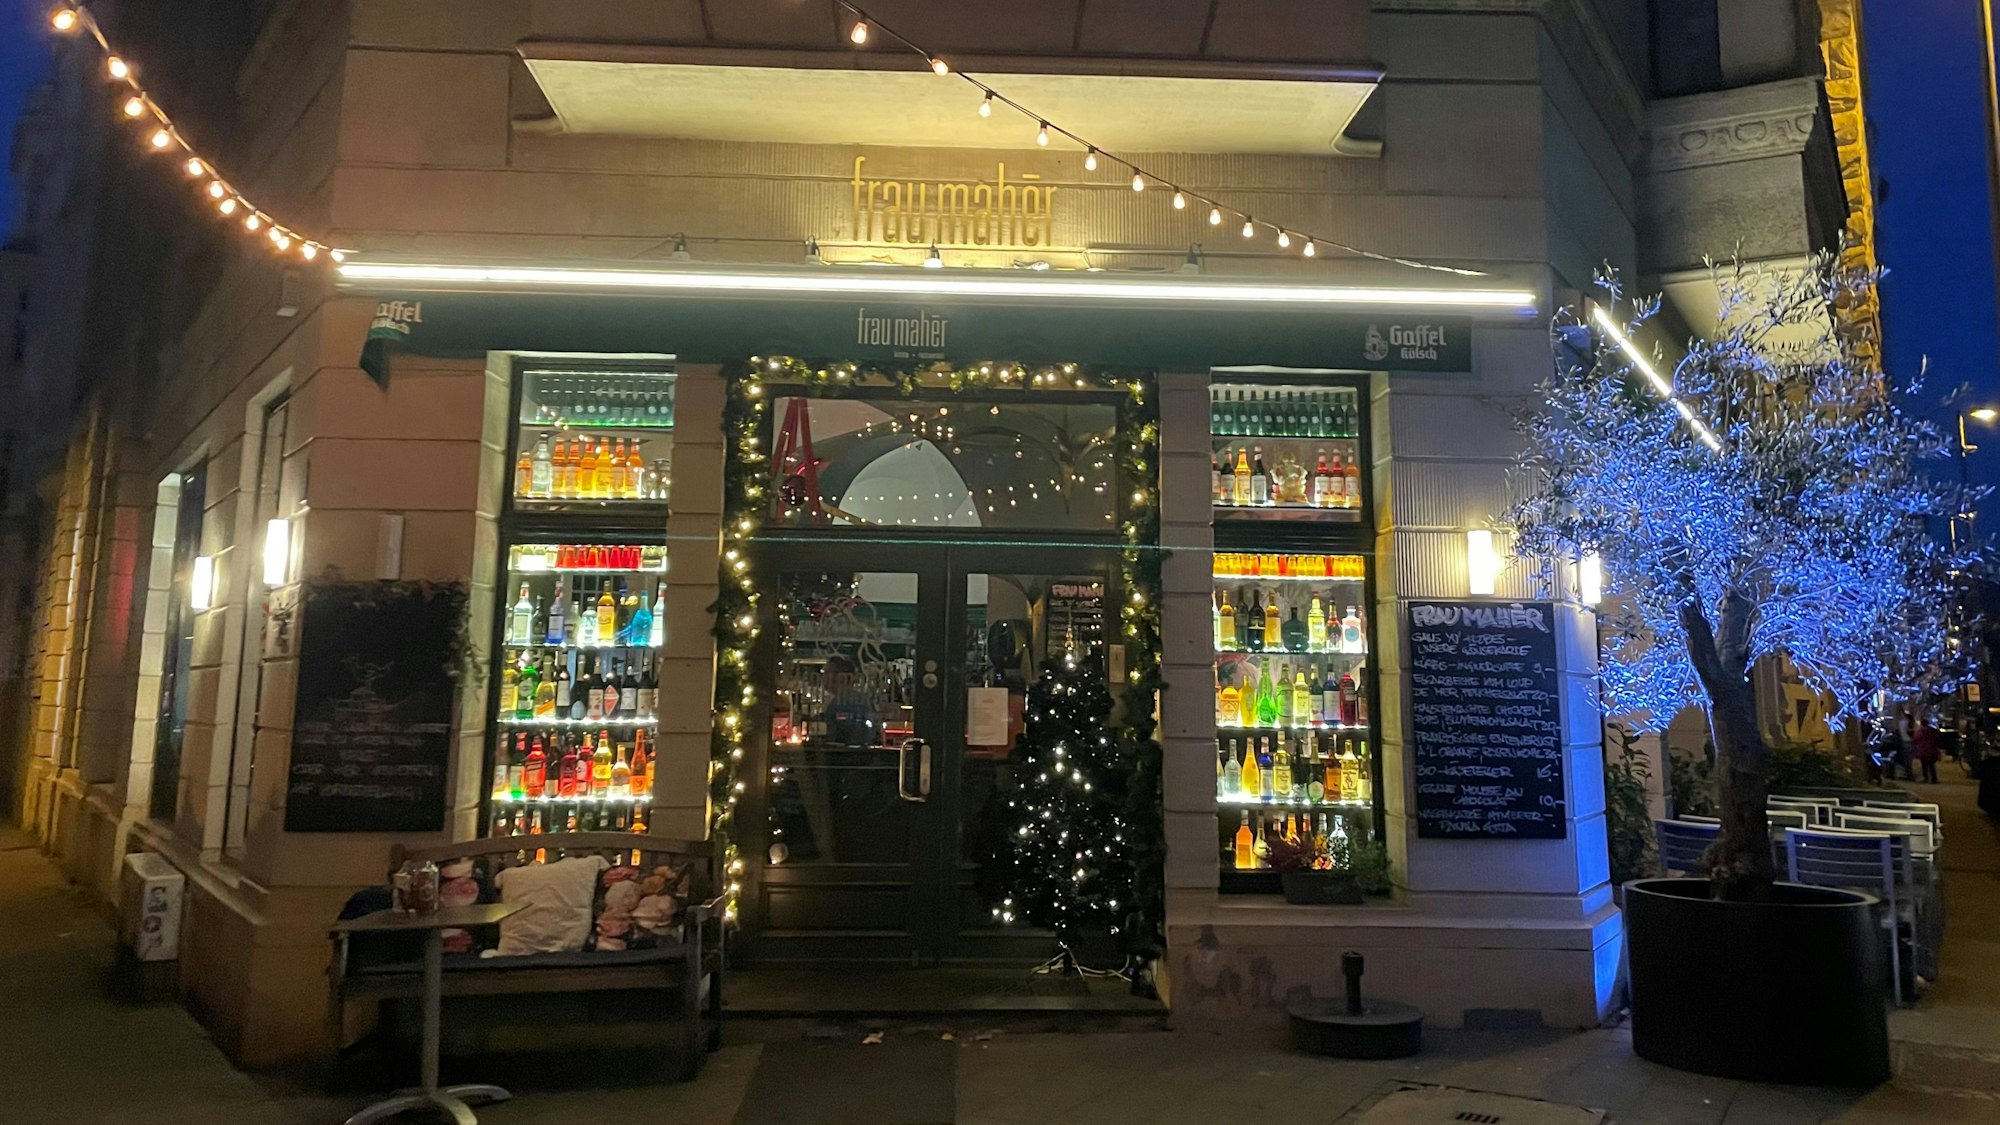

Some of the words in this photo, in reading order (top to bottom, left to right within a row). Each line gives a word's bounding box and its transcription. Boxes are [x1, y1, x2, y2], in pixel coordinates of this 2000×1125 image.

[851, 156, 926, 243] frau
[857, 308, 891, 345] frau
[893, 309, 949, 348] mahēr
[1390, 325, 1447, 347] Gaffel
